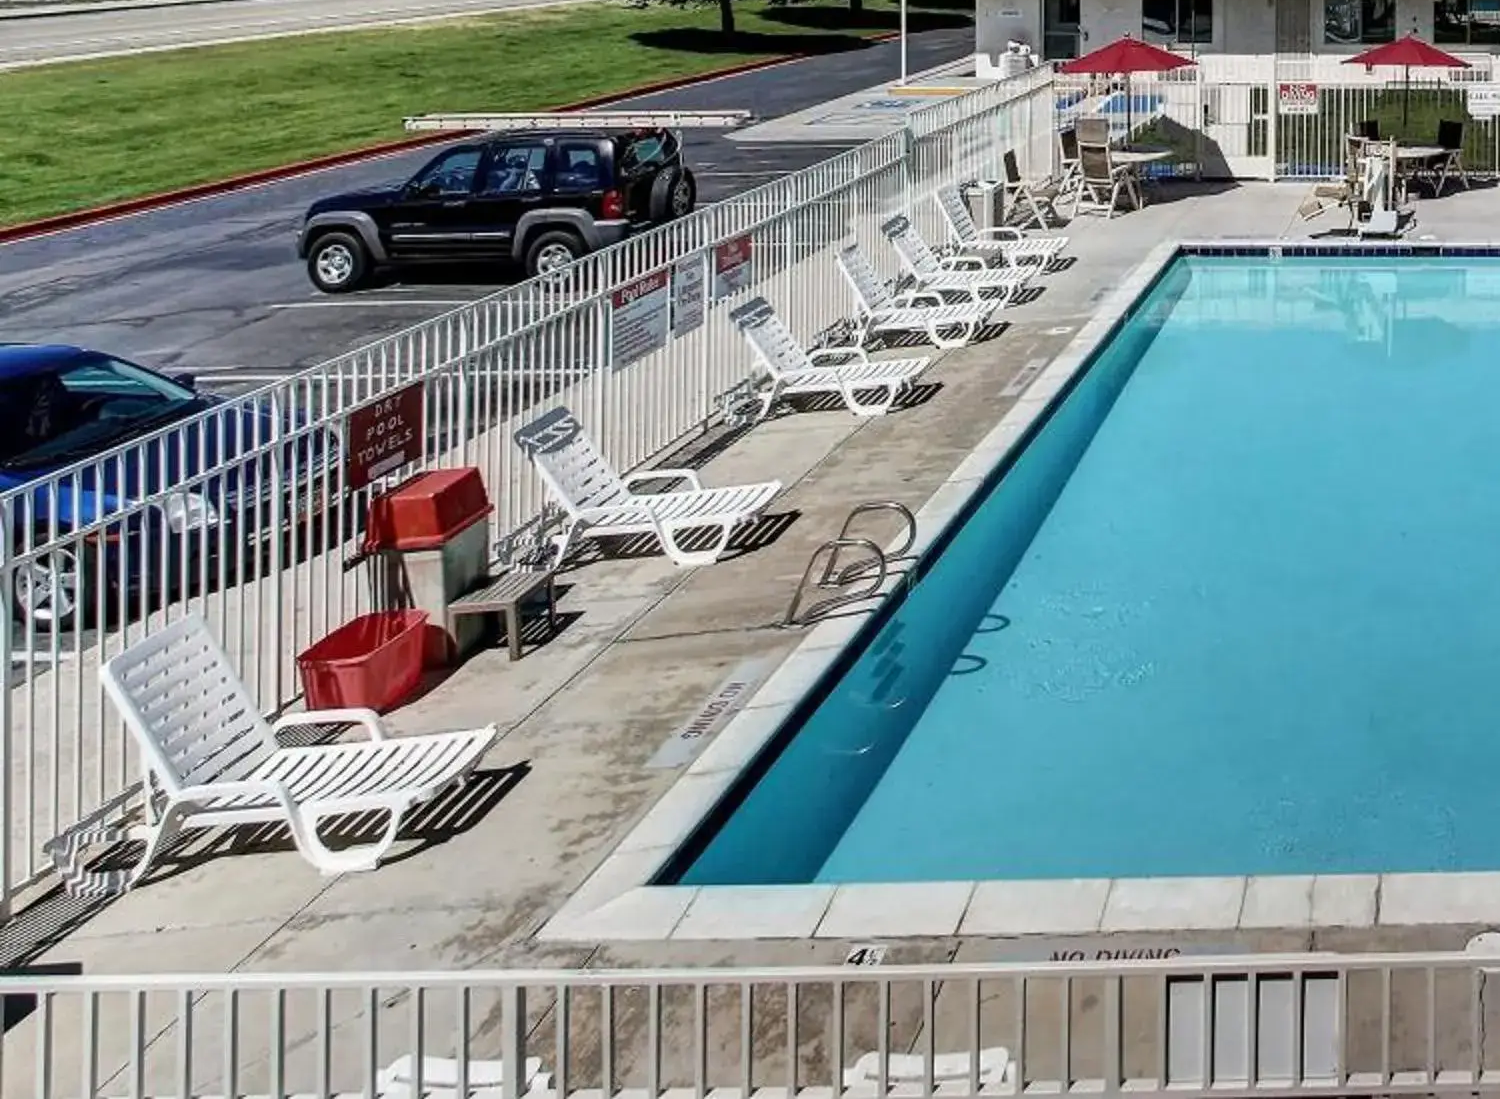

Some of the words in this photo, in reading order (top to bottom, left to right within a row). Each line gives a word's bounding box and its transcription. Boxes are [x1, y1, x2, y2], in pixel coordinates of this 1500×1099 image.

[375, 395, 402, 417] DRY
[366, 415, 404, 441] POOL
[357, 428, 413, 465] TOWELS
